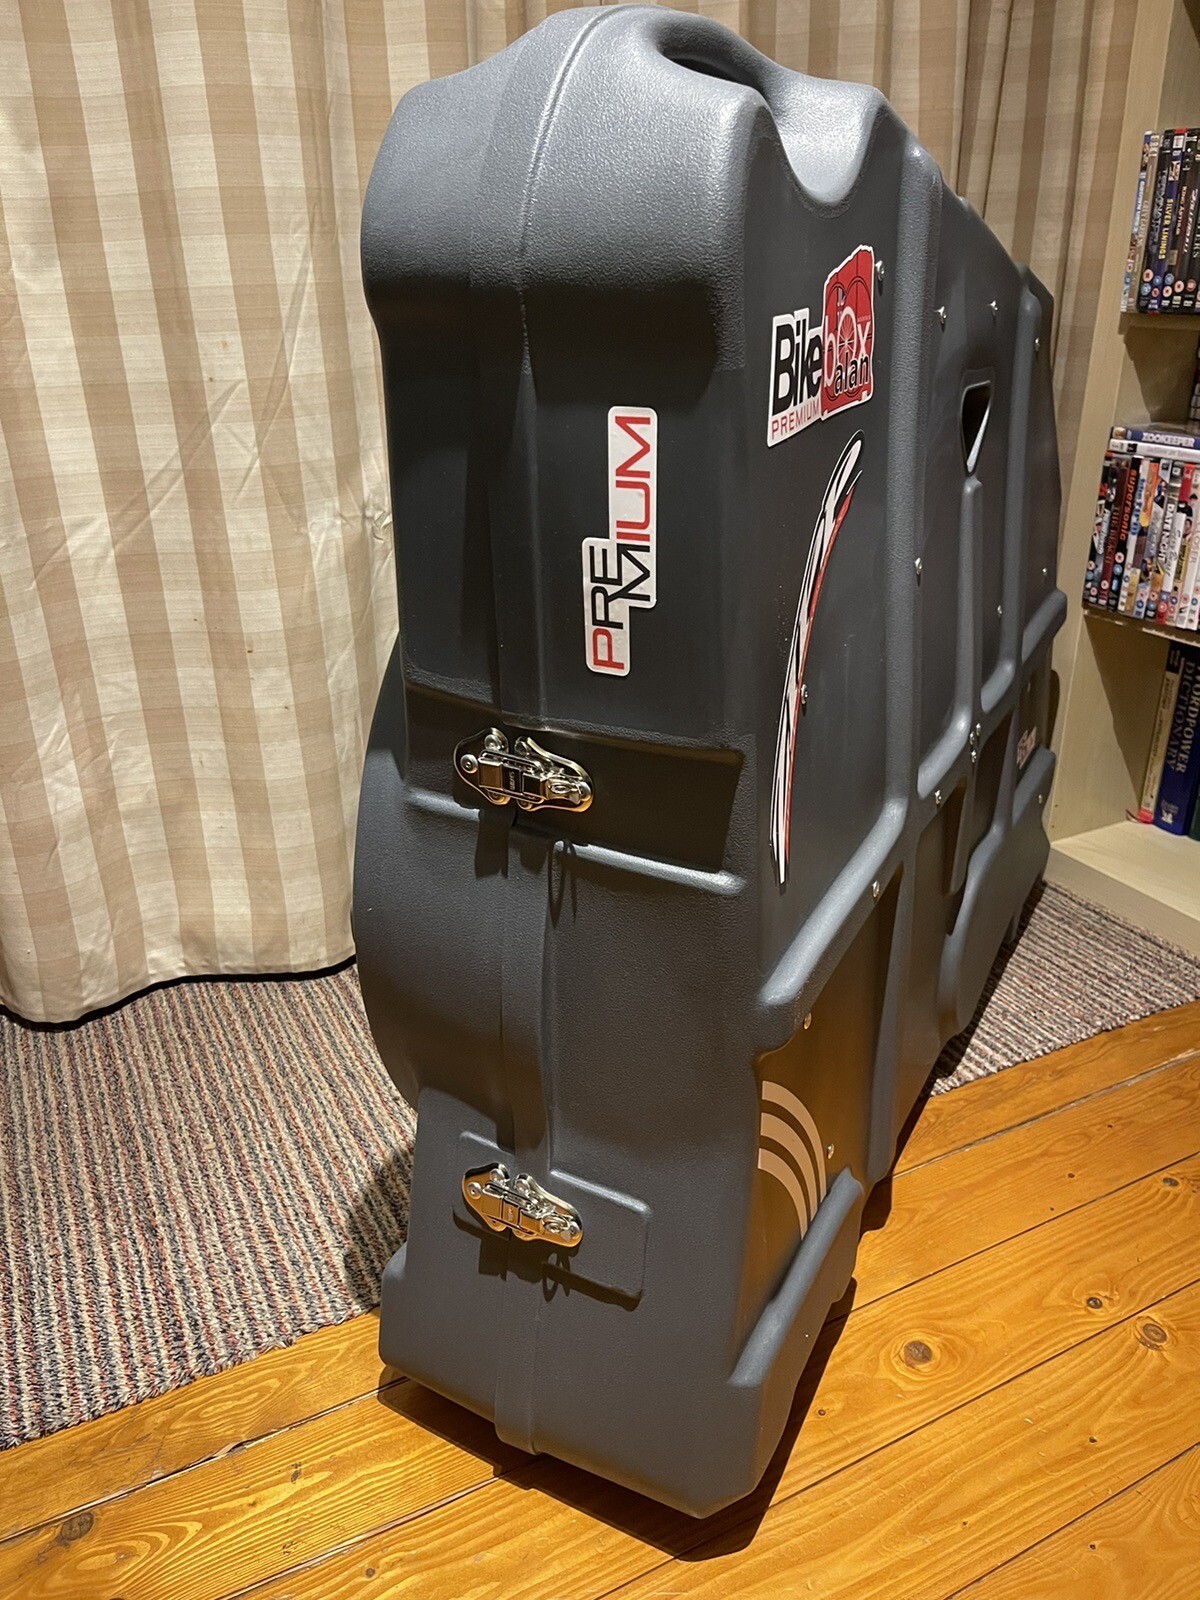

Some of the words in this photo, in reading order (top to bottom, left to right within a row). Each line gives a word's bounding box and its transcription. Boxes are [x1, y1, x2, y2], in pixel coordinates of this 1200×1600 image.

[1164, 198, 1174, 226] SILVER
[1158, 228, 1169, 259] LININGS
[834, 352, 870, 396] alan
[771, 401, 820, 440] PREMIUM
[1141, 432, 1195, 448] ZOOKEEPER
[1120, 468, 1138, 541] supersonic
[1163, 503, 1175, 529] DATE
[1158, 531, 1170, 561] NIGHT
[1167, 661, 1195, 770] DICTIONARY
